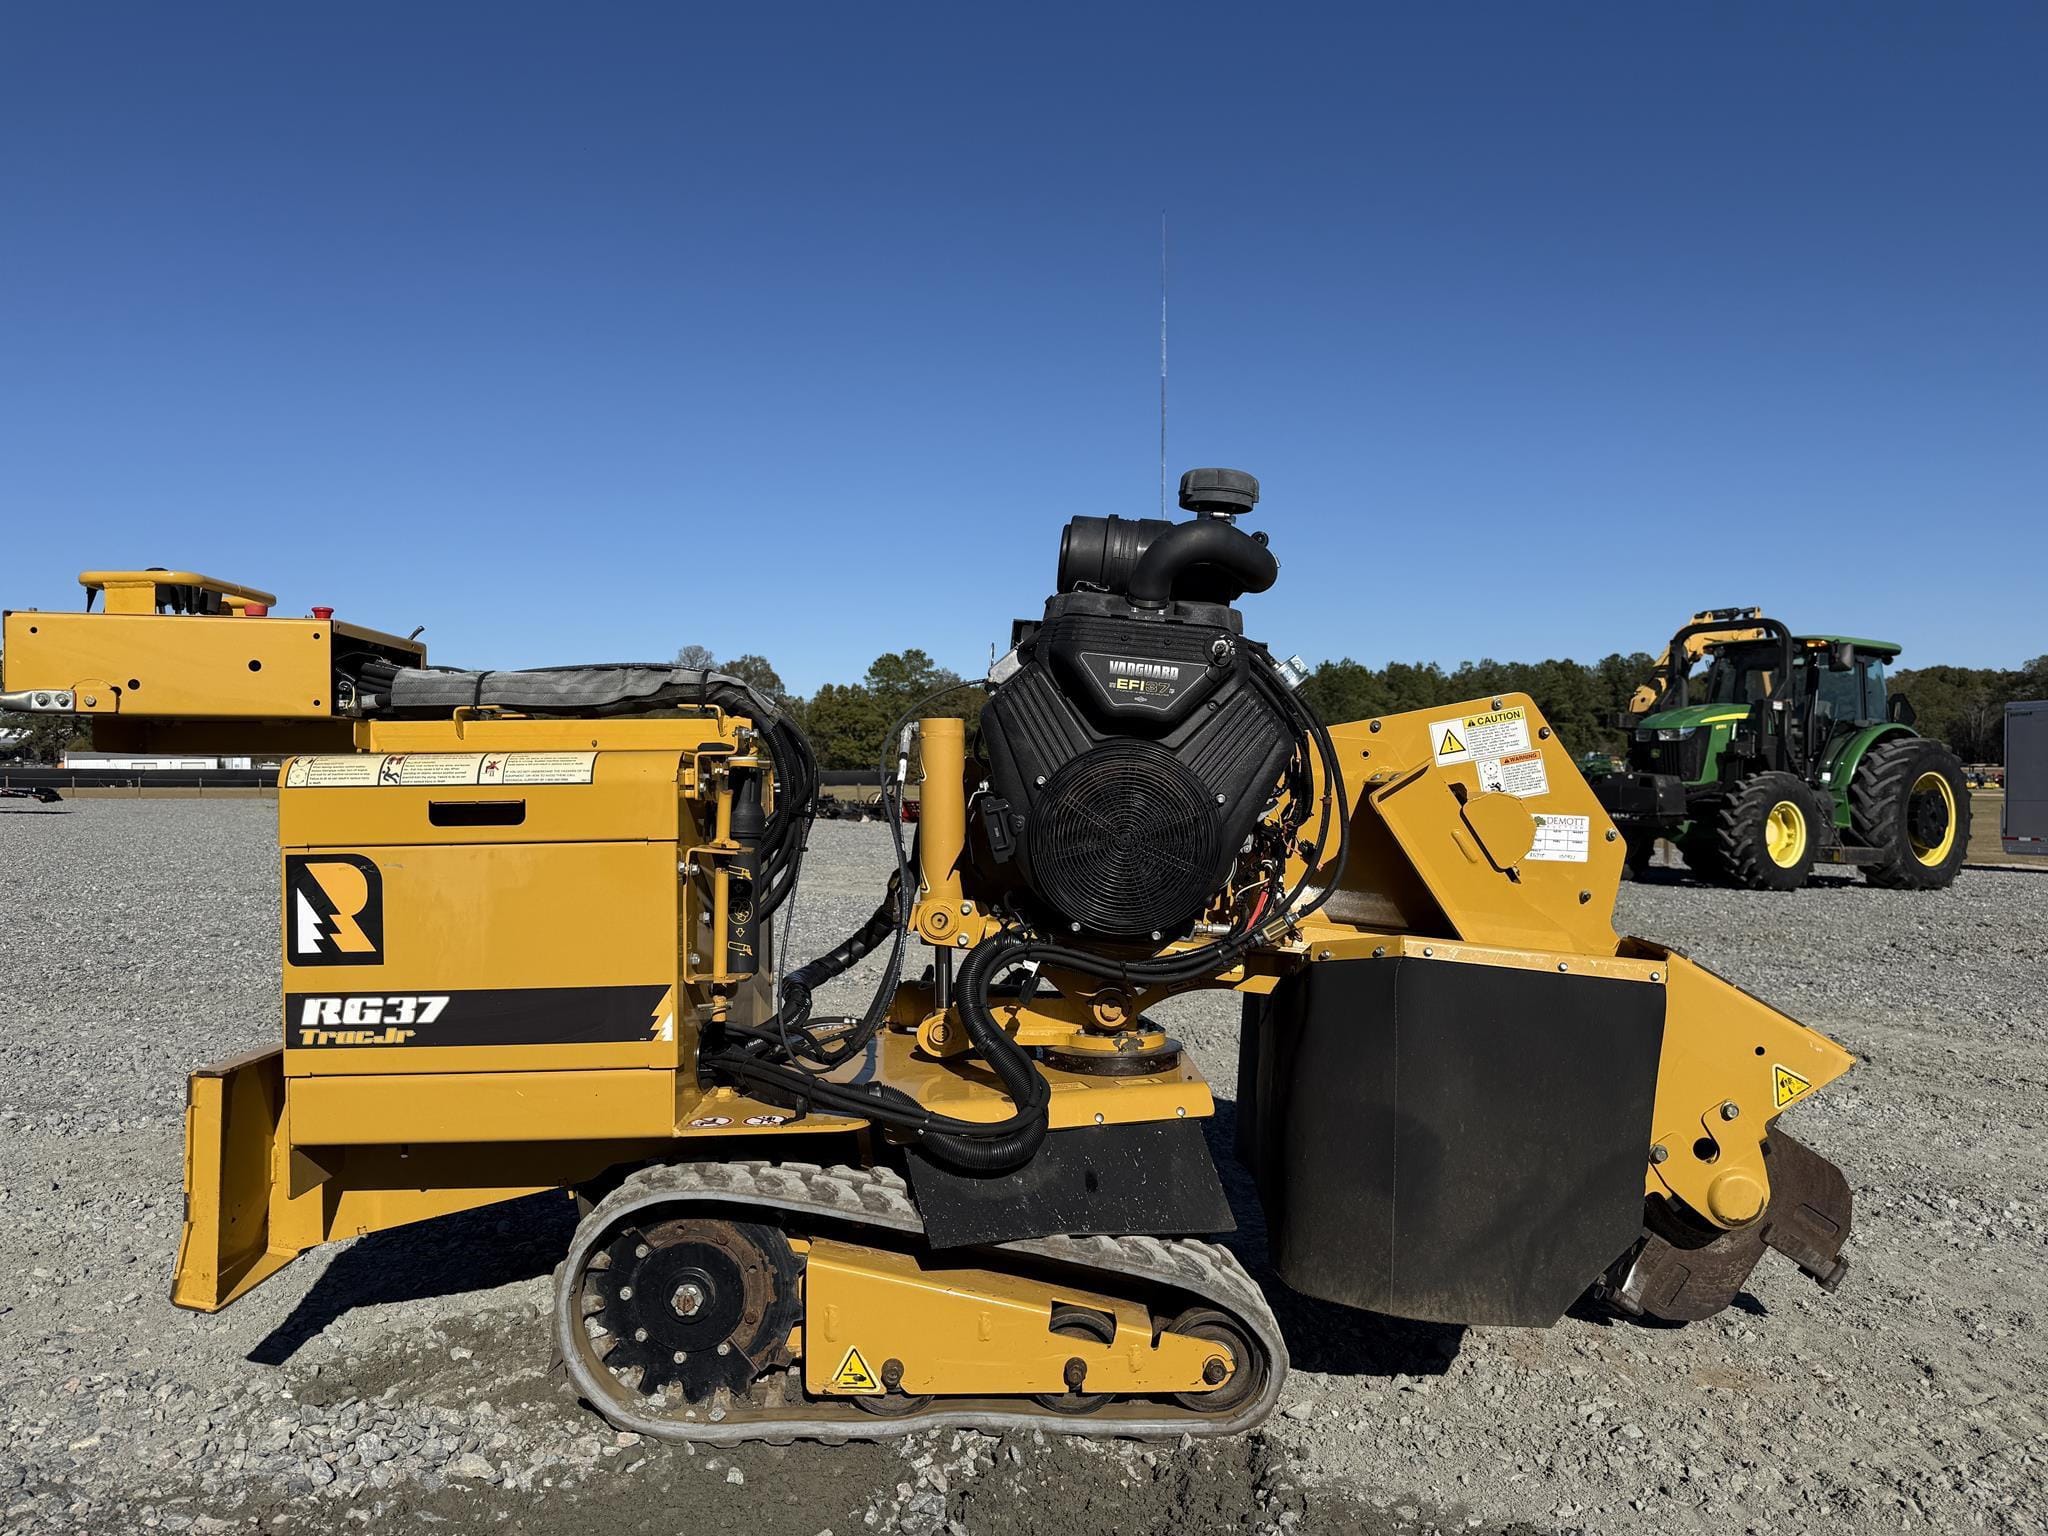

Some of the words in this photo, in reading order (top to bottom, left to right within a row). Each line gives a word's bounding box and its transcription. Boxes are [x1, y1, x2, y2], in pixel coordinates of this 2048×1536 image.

[1109, 660, 1179, 681] VANGUARD
[1477, 710, 1521, 725] CAUTION
[1509, 752, 1537, 763] WARNING
[1547, 816, 1585, 826] DEMOTT
[300, 996, 450, 1026] RG37
